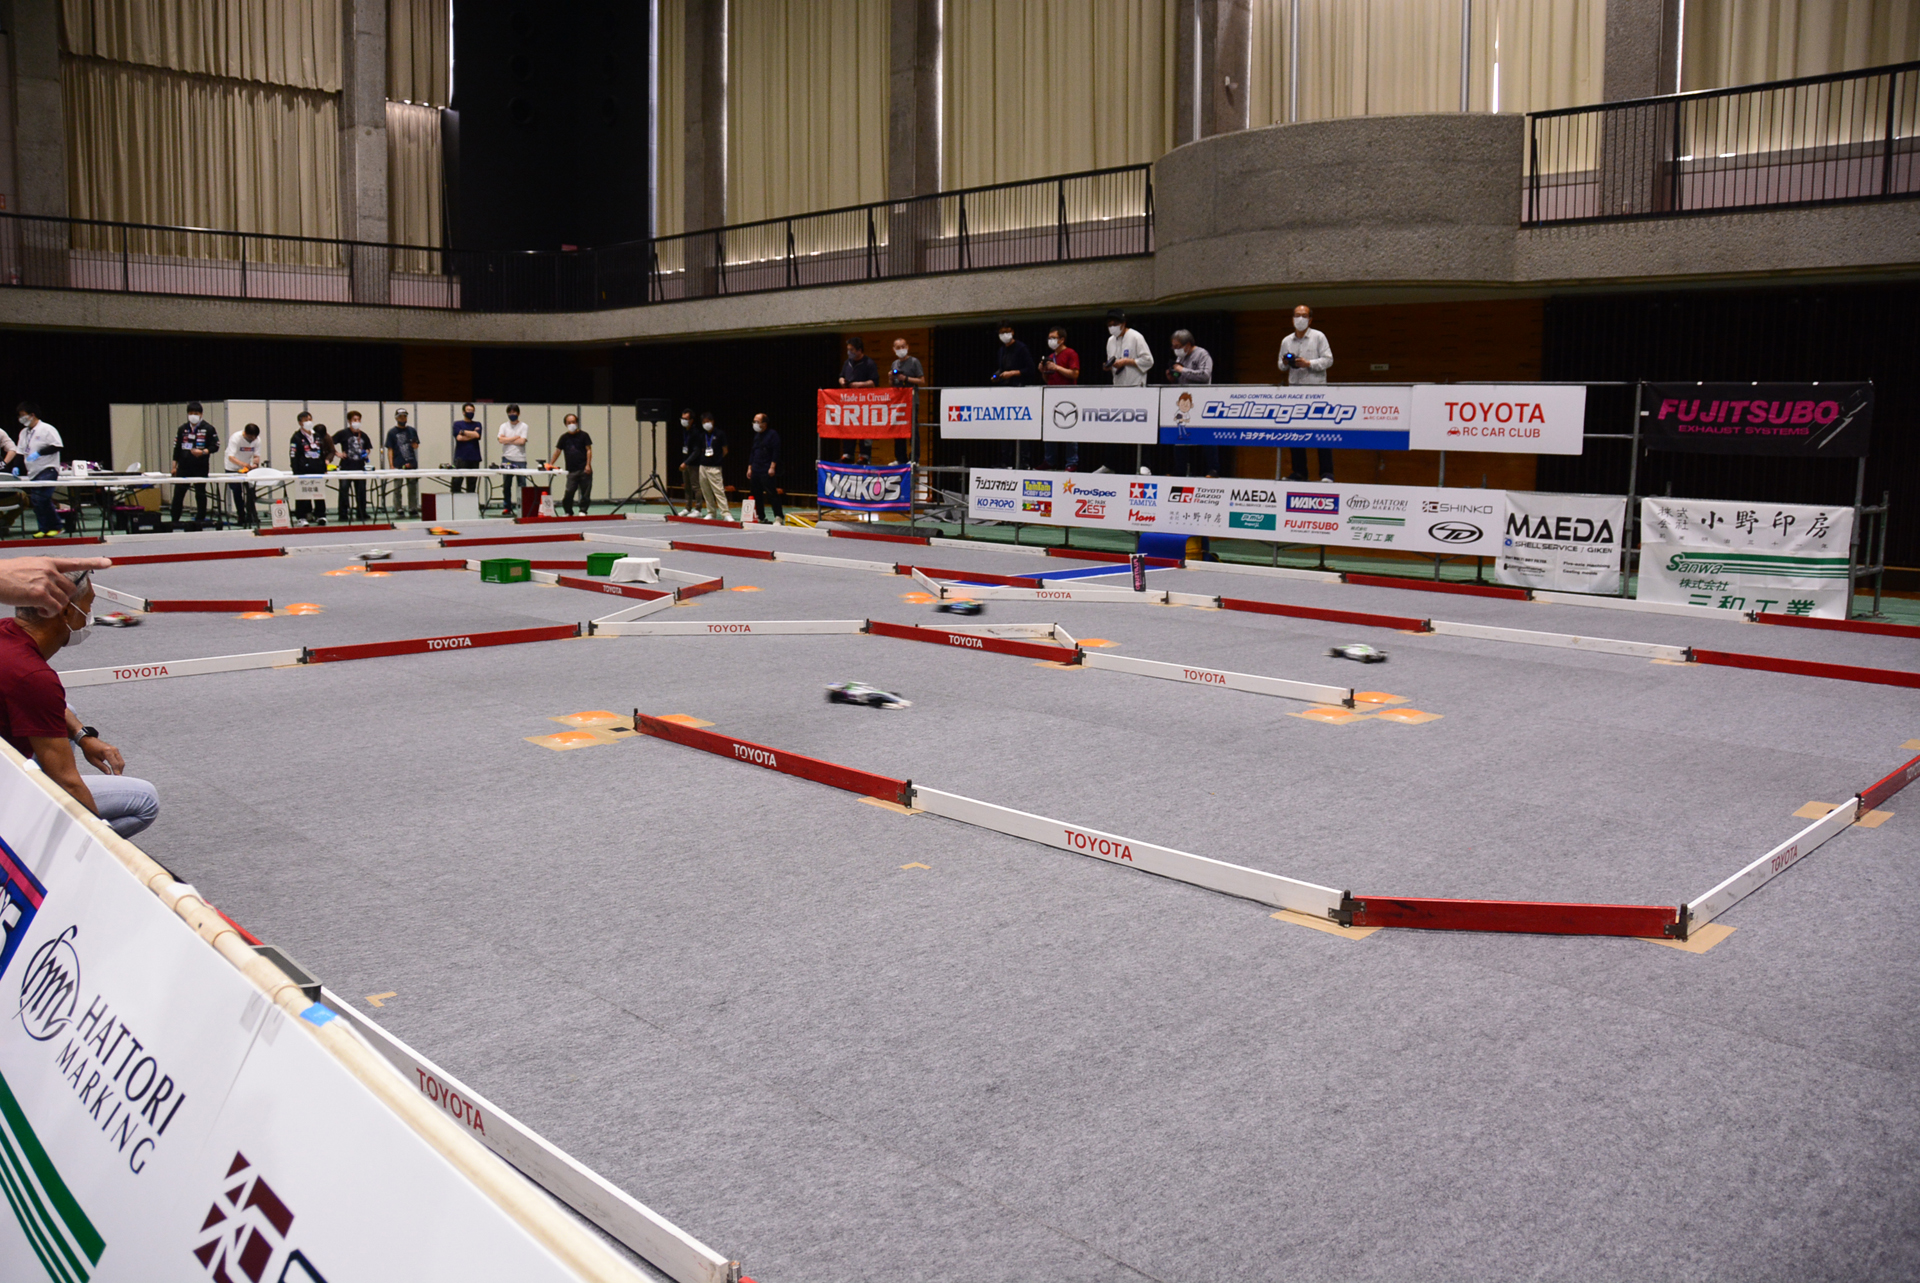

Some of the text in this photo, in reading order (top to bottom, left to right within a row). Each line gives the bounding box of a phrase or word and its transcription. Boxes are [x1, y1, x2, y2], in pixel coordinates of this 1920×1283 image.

[840, 393, 858, 402] Made
[860, 394, 866, 402] in
[825, 403, 909, 426] BRIDE
[973, 406, 1033, 420] TAMIYA
[1362, 406, 1400, 415] TOYOTA
[1445, 402, 1545, 423] TOYOTA
[1658, 399, 1839, 425] FUJITSUBO
[1239, 432, 1313, 442] トヨタチャレンジカップ
[1462, 427, 1541, 438] RC CAR CLUB
[1679, 425, 1809, 435] EXHAUST SYSTEMS
[975, 476, 1018, 491] ラジコンマガジン
[1129, 499, 1157, 507] TAMIYA
[1230, 489, 1277, 503] MAEDA
[977, 498, 988, 507] KO
[989, 499, 1015, 509] PROPO
[1440, 503, 1493, 514] SHINKO
[1284, 520, 1339, 531] FUJITSUBO
[1506, 513, 1614, 543] MAEDA
[1701, 510, 1830, 538] 小野印房
[1666, 554, 1724, 575] Sanwa
[1679, 578, 1729, 592] 株式会社
[1036, 591, 1071, 599] TOYOTA
[708, 625, 751, 633] TOYOTA
[427, 637, 472, 649] TOYOTA
[949, 635, 983, 648] TOYOTA
[113, 666, 169, 680] TOYOTA
[1183, 669, 1226, 684] TOYOTA
[733, 743, 777, 767] TOYOTA
[1064, 830, 1133, 862] TOYOTA
[1771, 845, 1798, 874] TOYOTA
[76, 995, 186, 1136] HATTORI
[55, 1038, 155, 1175] MARKING
[416, 1068, 485, 1136] TOYOTA
